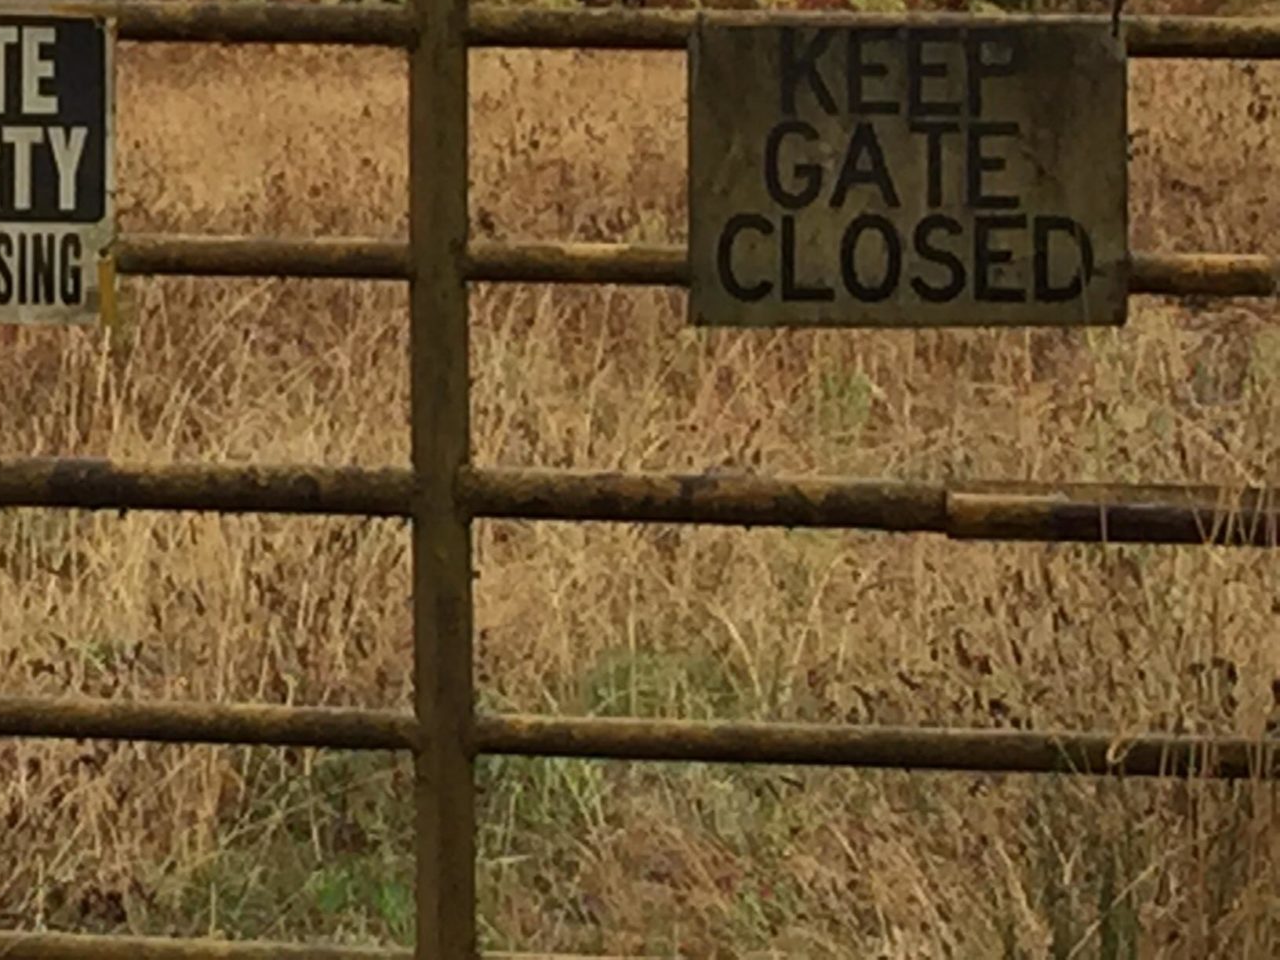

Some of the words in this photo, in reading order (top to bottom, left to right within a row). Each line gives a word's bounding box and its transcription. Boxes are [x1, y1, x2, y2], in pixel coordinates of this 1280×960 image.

[780, 27, 1019, 117] KEEP
[764, 120, 1020, 210] GATE
[717, 213, 1095, 304] CLOSED
